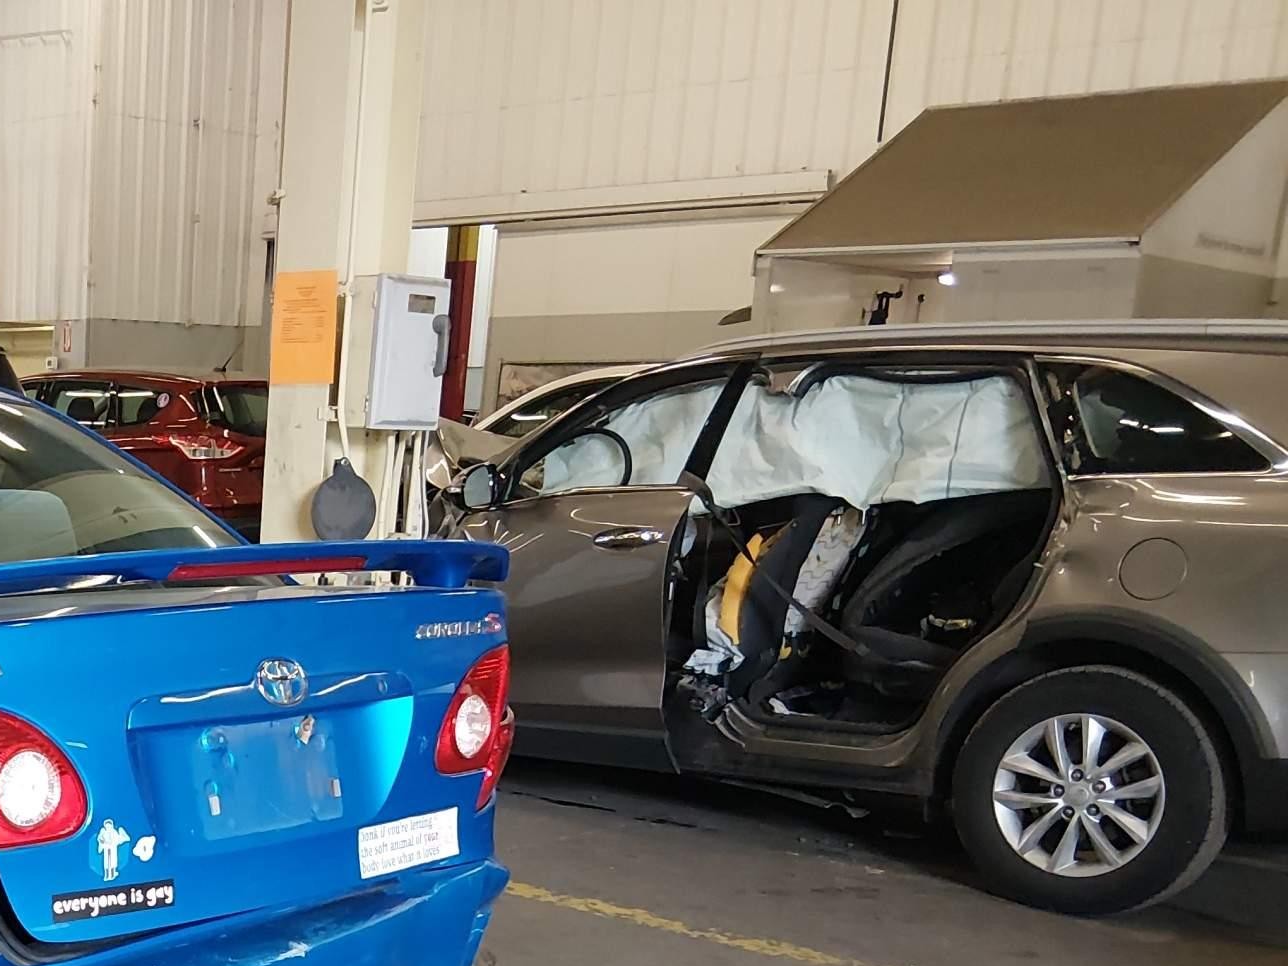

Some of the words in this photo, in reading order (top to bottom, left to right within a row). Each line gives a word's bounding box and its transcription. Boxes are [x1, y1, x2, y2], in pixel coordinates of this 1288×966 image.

[53, 892, 127, 917] everyone
[130, 887, 144, 904] is
[146, 885, 173, 907] gay
